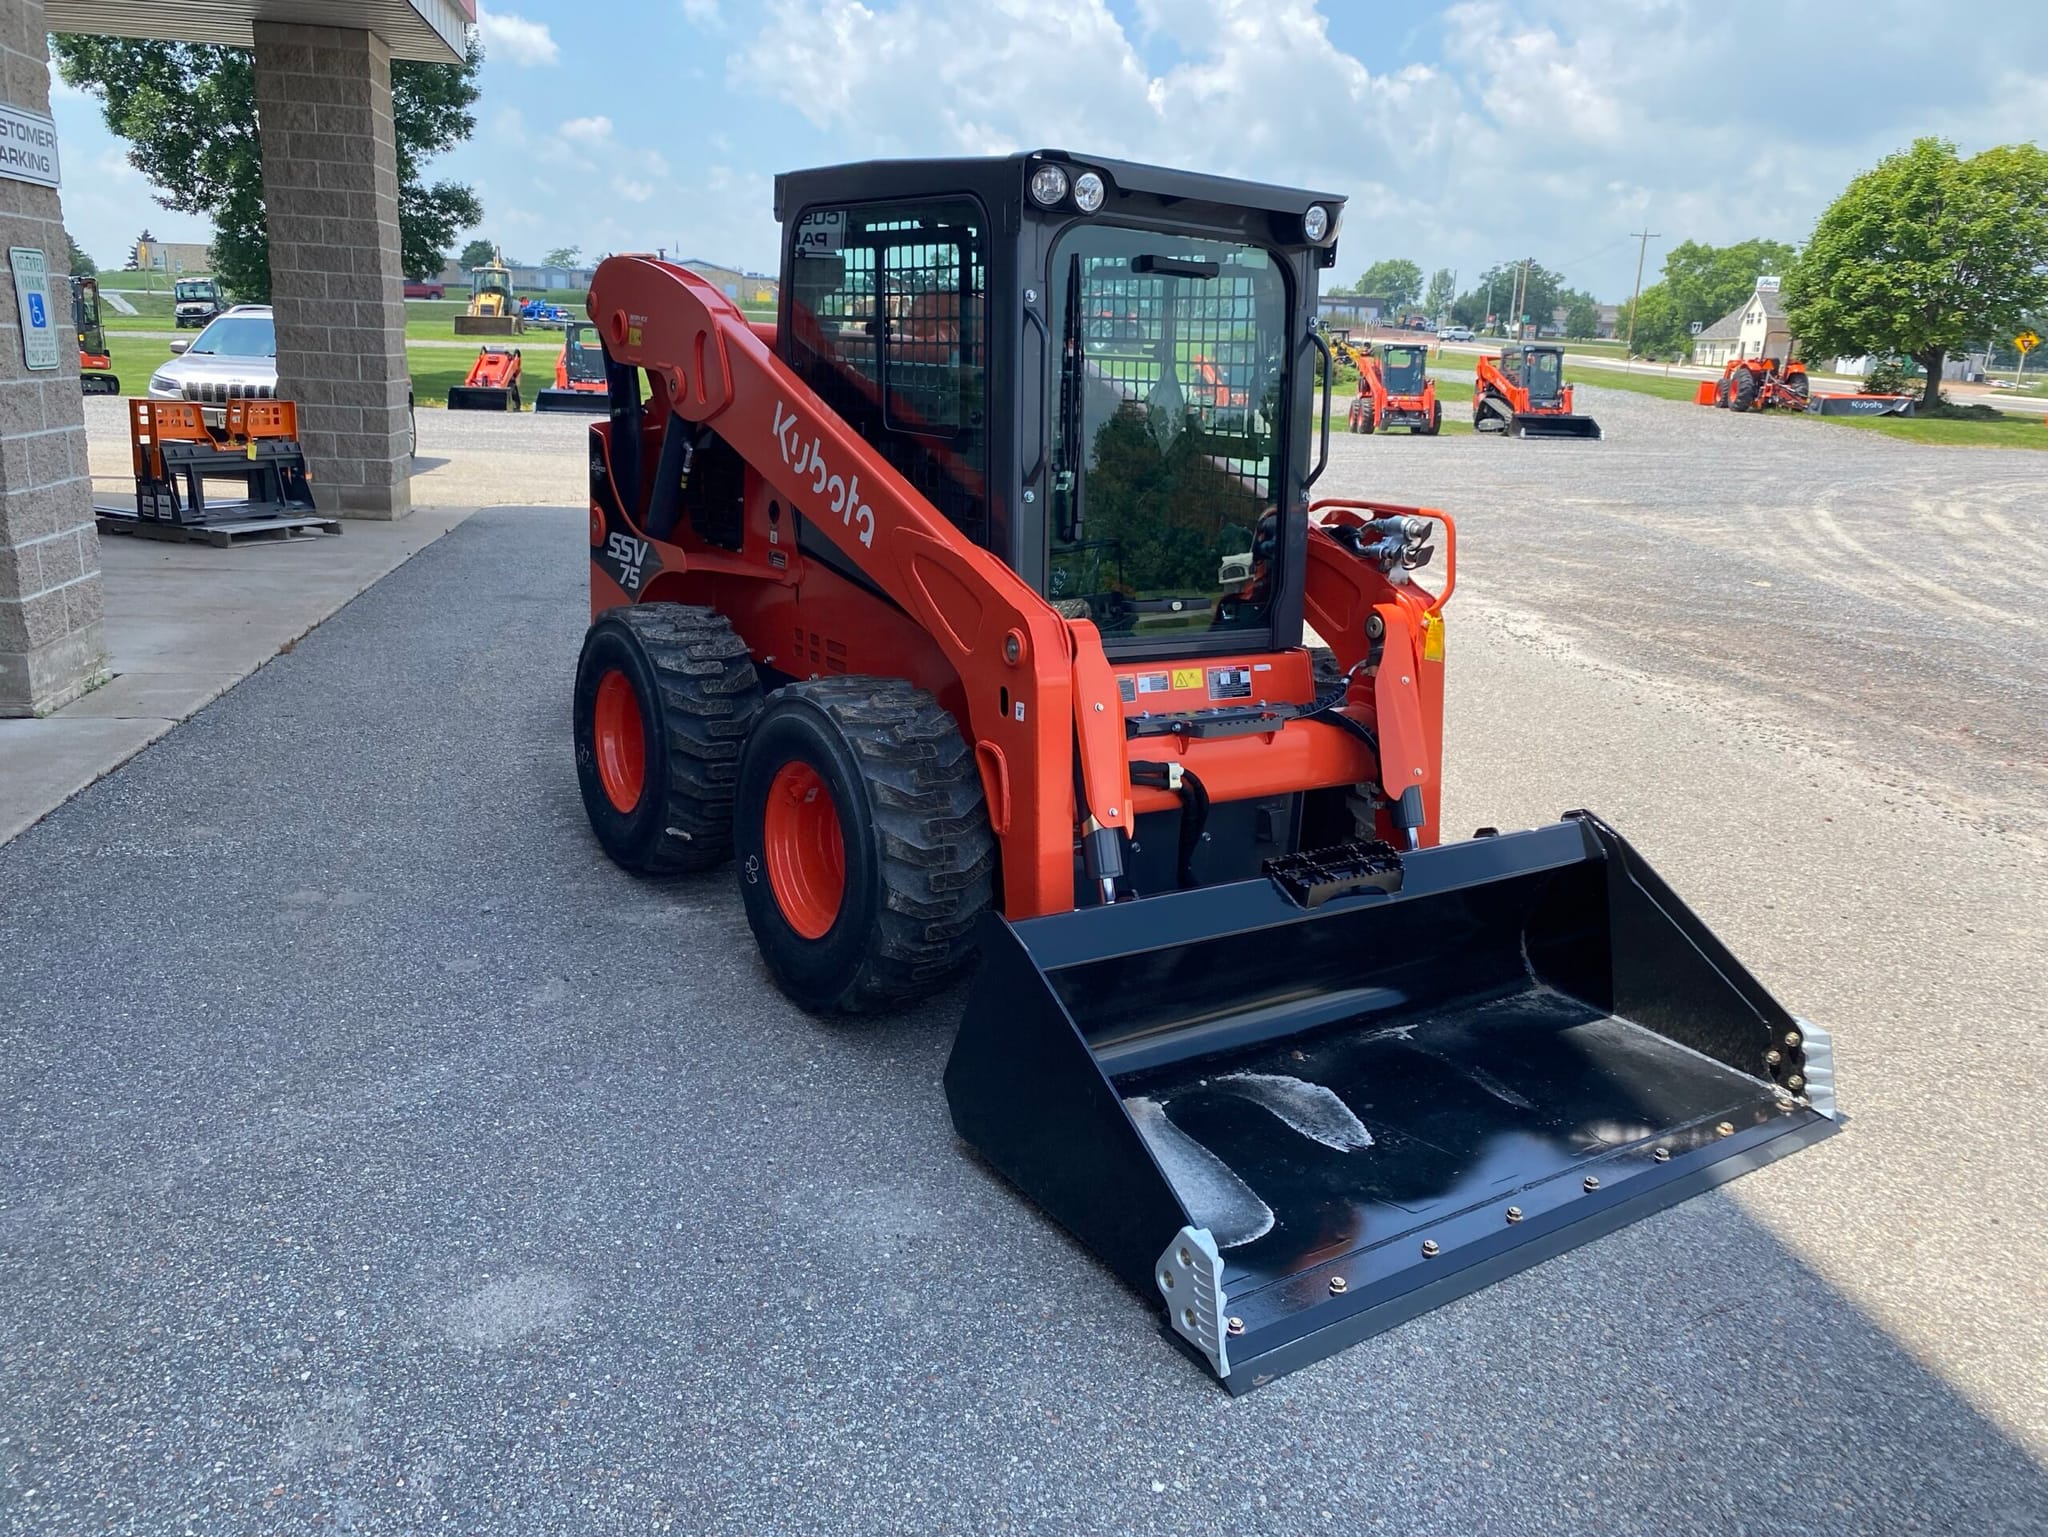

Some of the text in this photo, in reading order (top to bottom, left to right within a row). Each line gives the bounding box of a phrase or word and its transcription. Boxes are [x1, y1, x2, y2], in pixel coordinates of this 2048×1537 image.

[0, 119, 54, 149] STOMER
[0, 145, 50, 173] ARKING
[1851, 401, 1883, 409] Kubota
[772, 400, 875, 549] Kubota
[607, 531, 649, 567] SSV
[619, 562, 641, 590] 75
